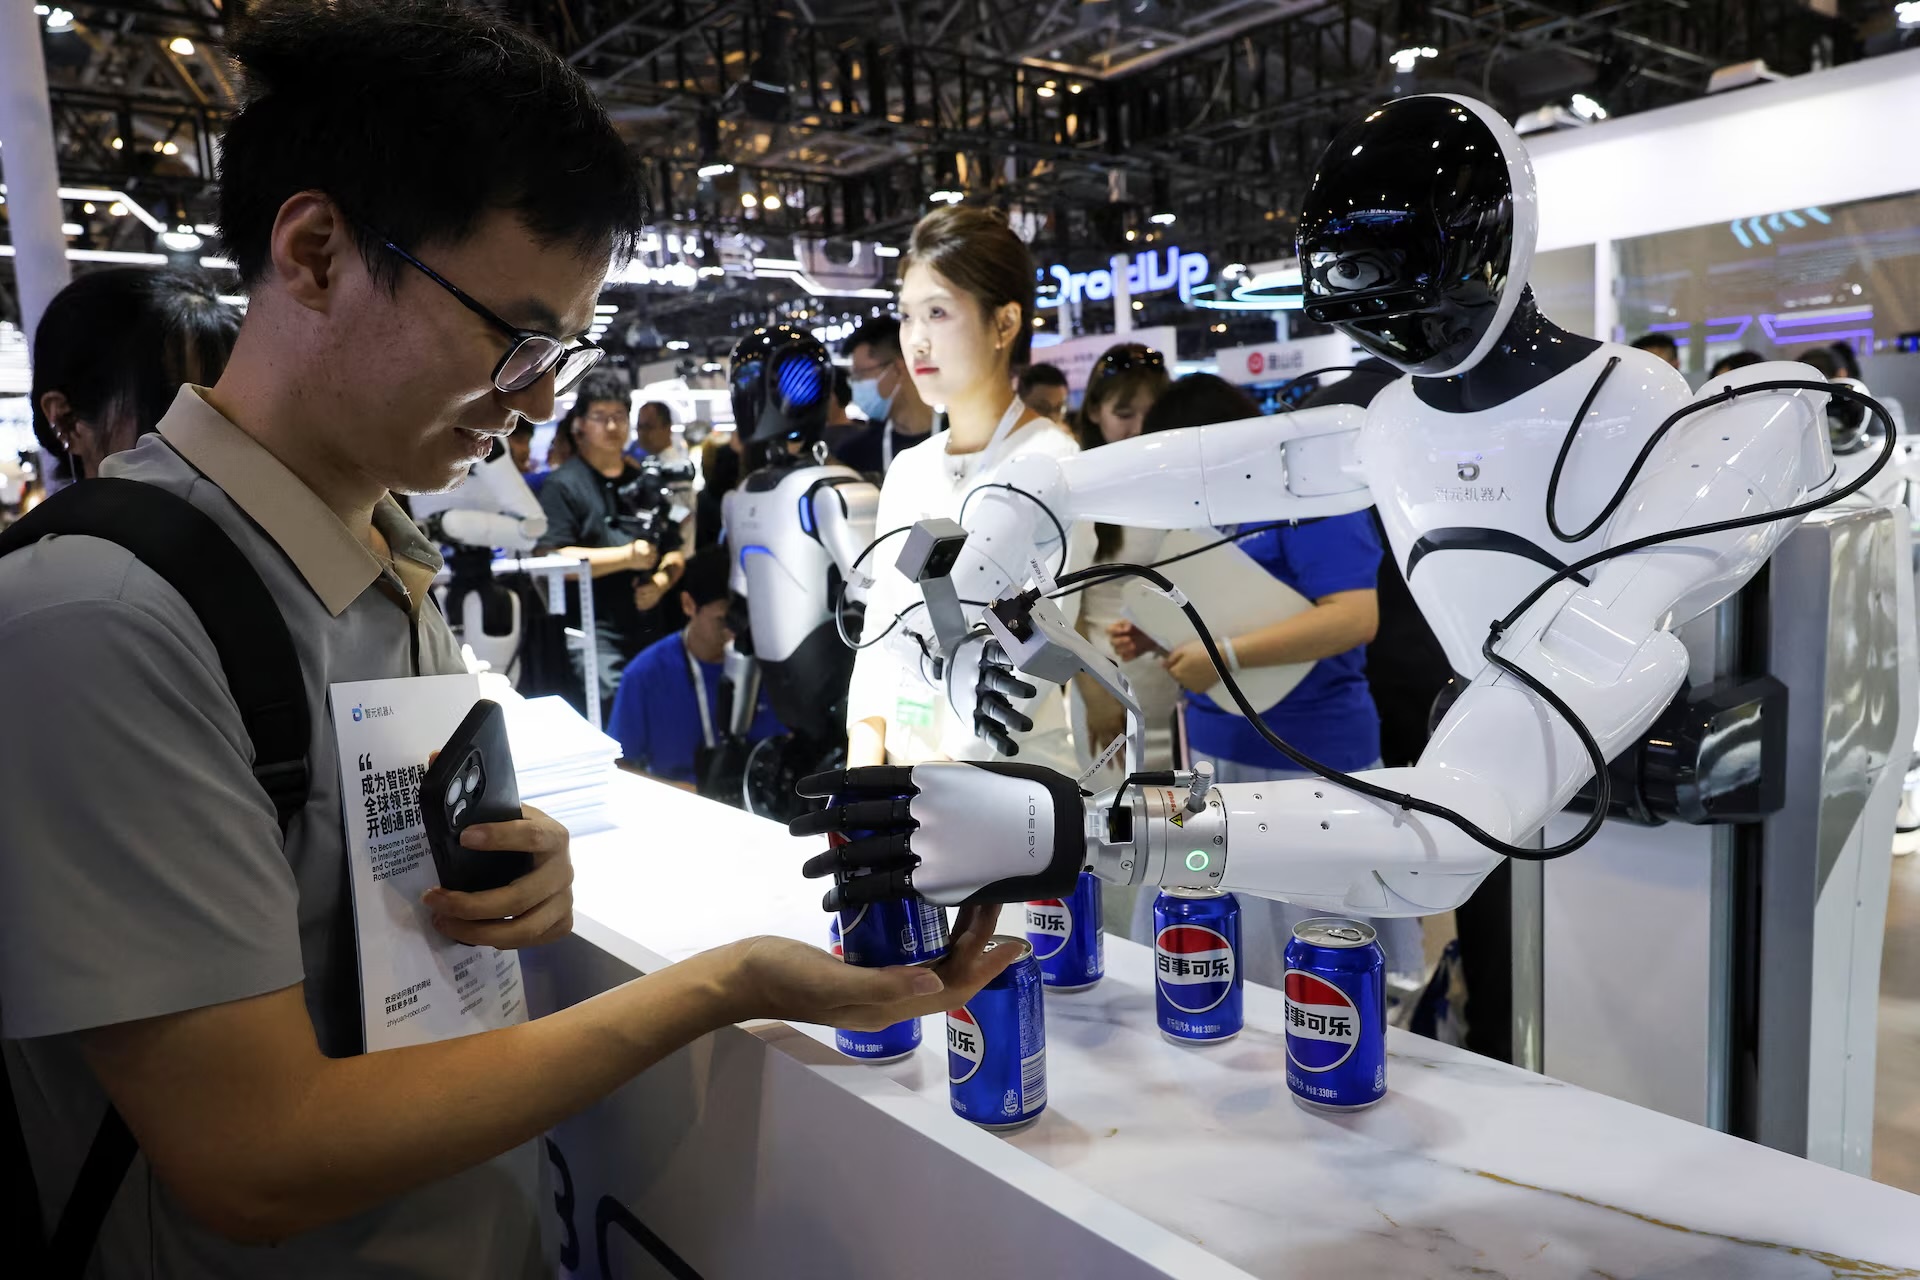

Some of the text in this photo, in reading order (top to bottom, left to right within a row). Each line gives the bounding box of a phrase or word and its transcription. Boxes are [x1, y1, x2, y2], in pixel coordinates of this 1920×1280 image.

[1434, 486, 1512, 502] 智元机器人
[364, 705, 395, 719] 智元机器人
[369, 846, 378, 854] To
[378, 840, 400, 852] Become
[404, 833, 420, 844] Global
[377, 847, 405, 859] Intelligent
[404, 842, 422, 853] Robots
[372, 864, 384, 873] and
[384, 858, 402, 869] Create
[406, 849, 425, 862] General
[373, 861, 420, 882] Robot Ecosystem
[1158, 952, 1230, 978] 百事可乐
